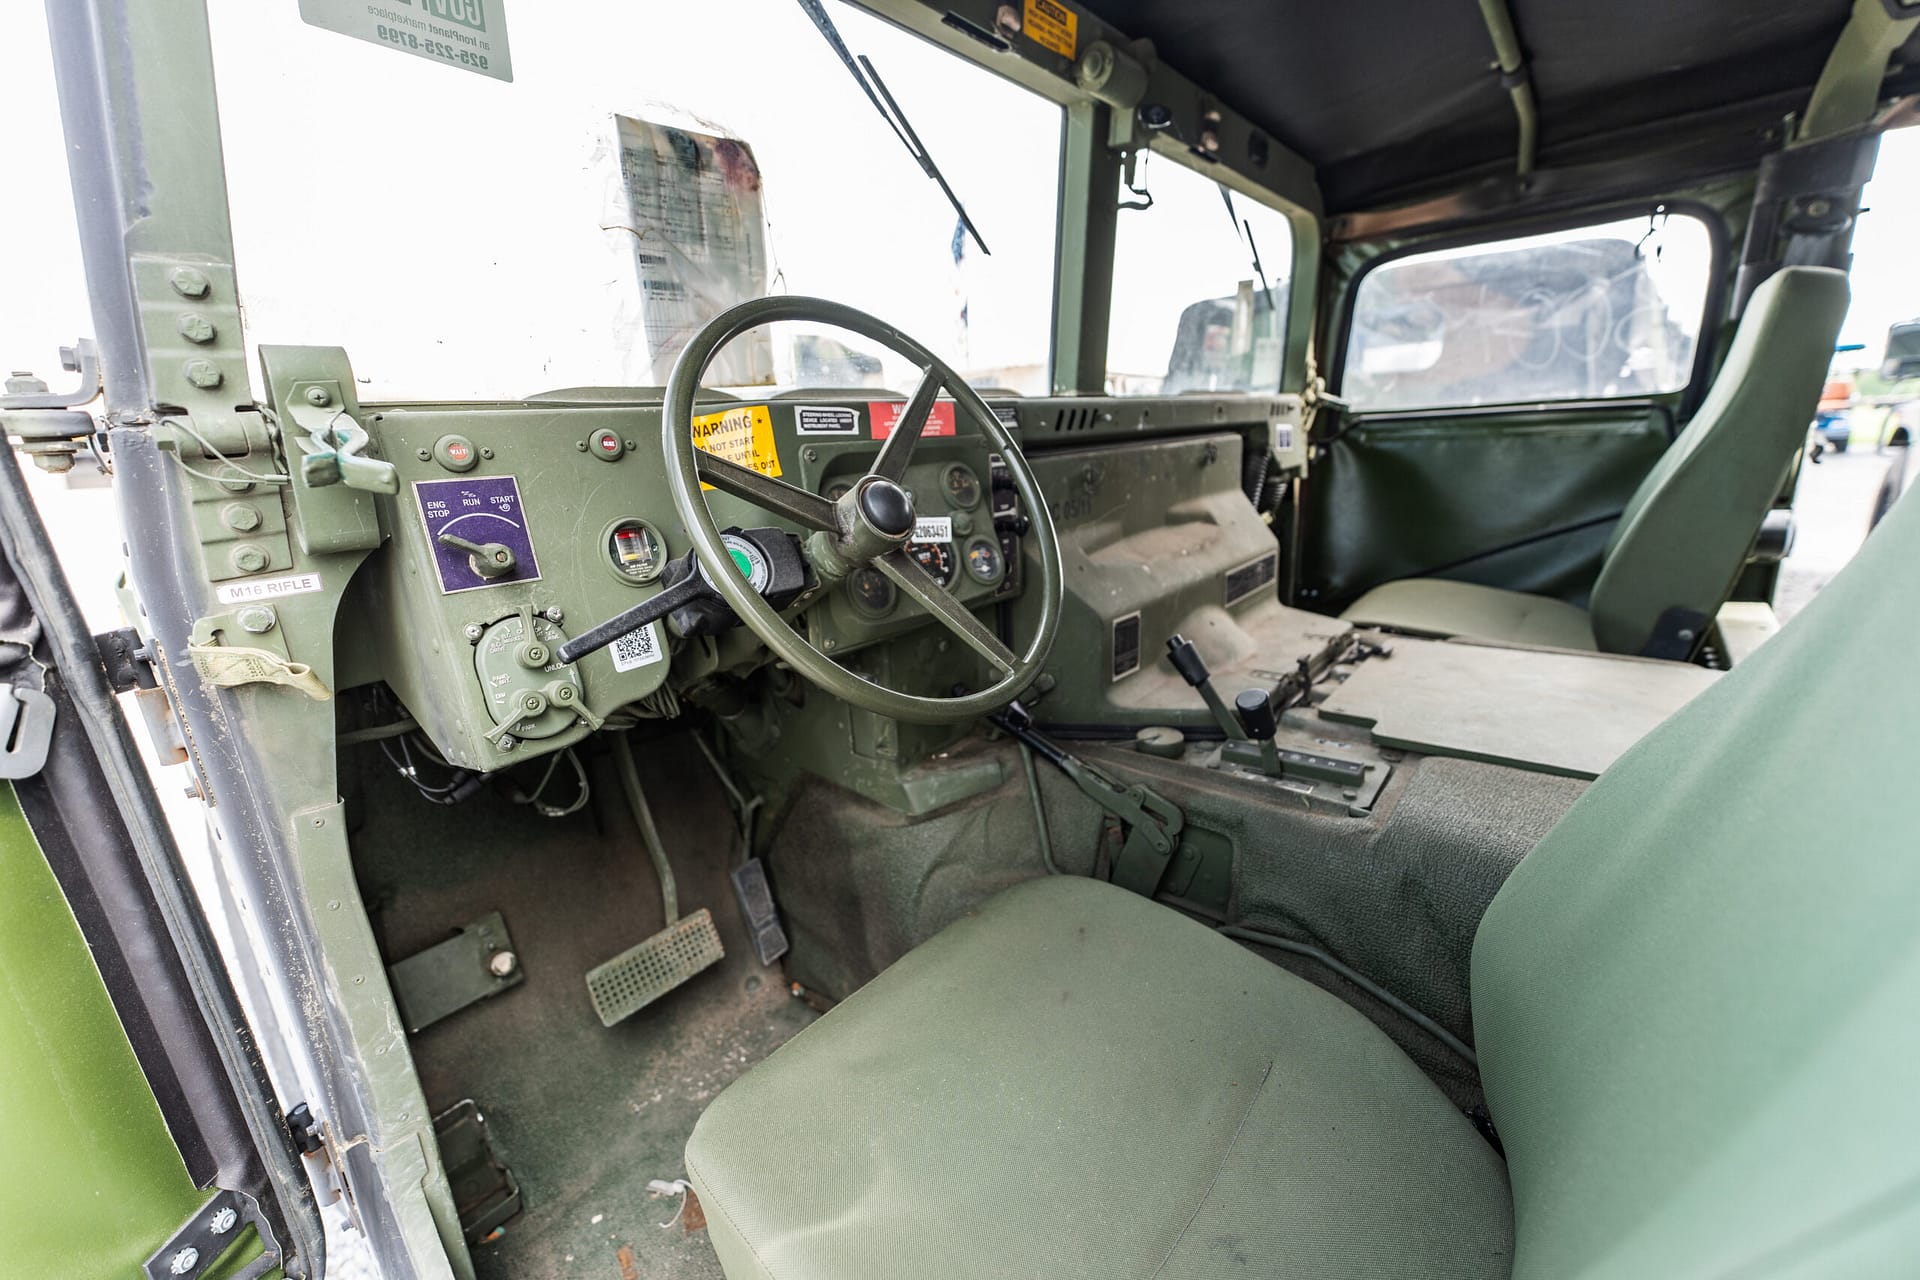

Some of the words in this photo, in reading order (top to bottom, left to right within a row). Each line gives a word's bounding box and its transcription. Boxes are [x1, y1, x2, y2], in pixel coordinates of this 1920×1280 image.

[709, 442, 726, 452] NOT
[729, 436, 755, 448] START
[734, 449, 760, 461] UNTIL
[760, 460, 775, 469] OUT
[463, 498, 480, 506] RUN
[490, 495, 514, 504] START
[427, 501, 446, 509] ENG
[427, 510, 450, 518] STOP
[230, 585, 262, 598] M16
[267, 578, 312, 593] RIFLE
[544, 662, 570, 673] UNLOC
